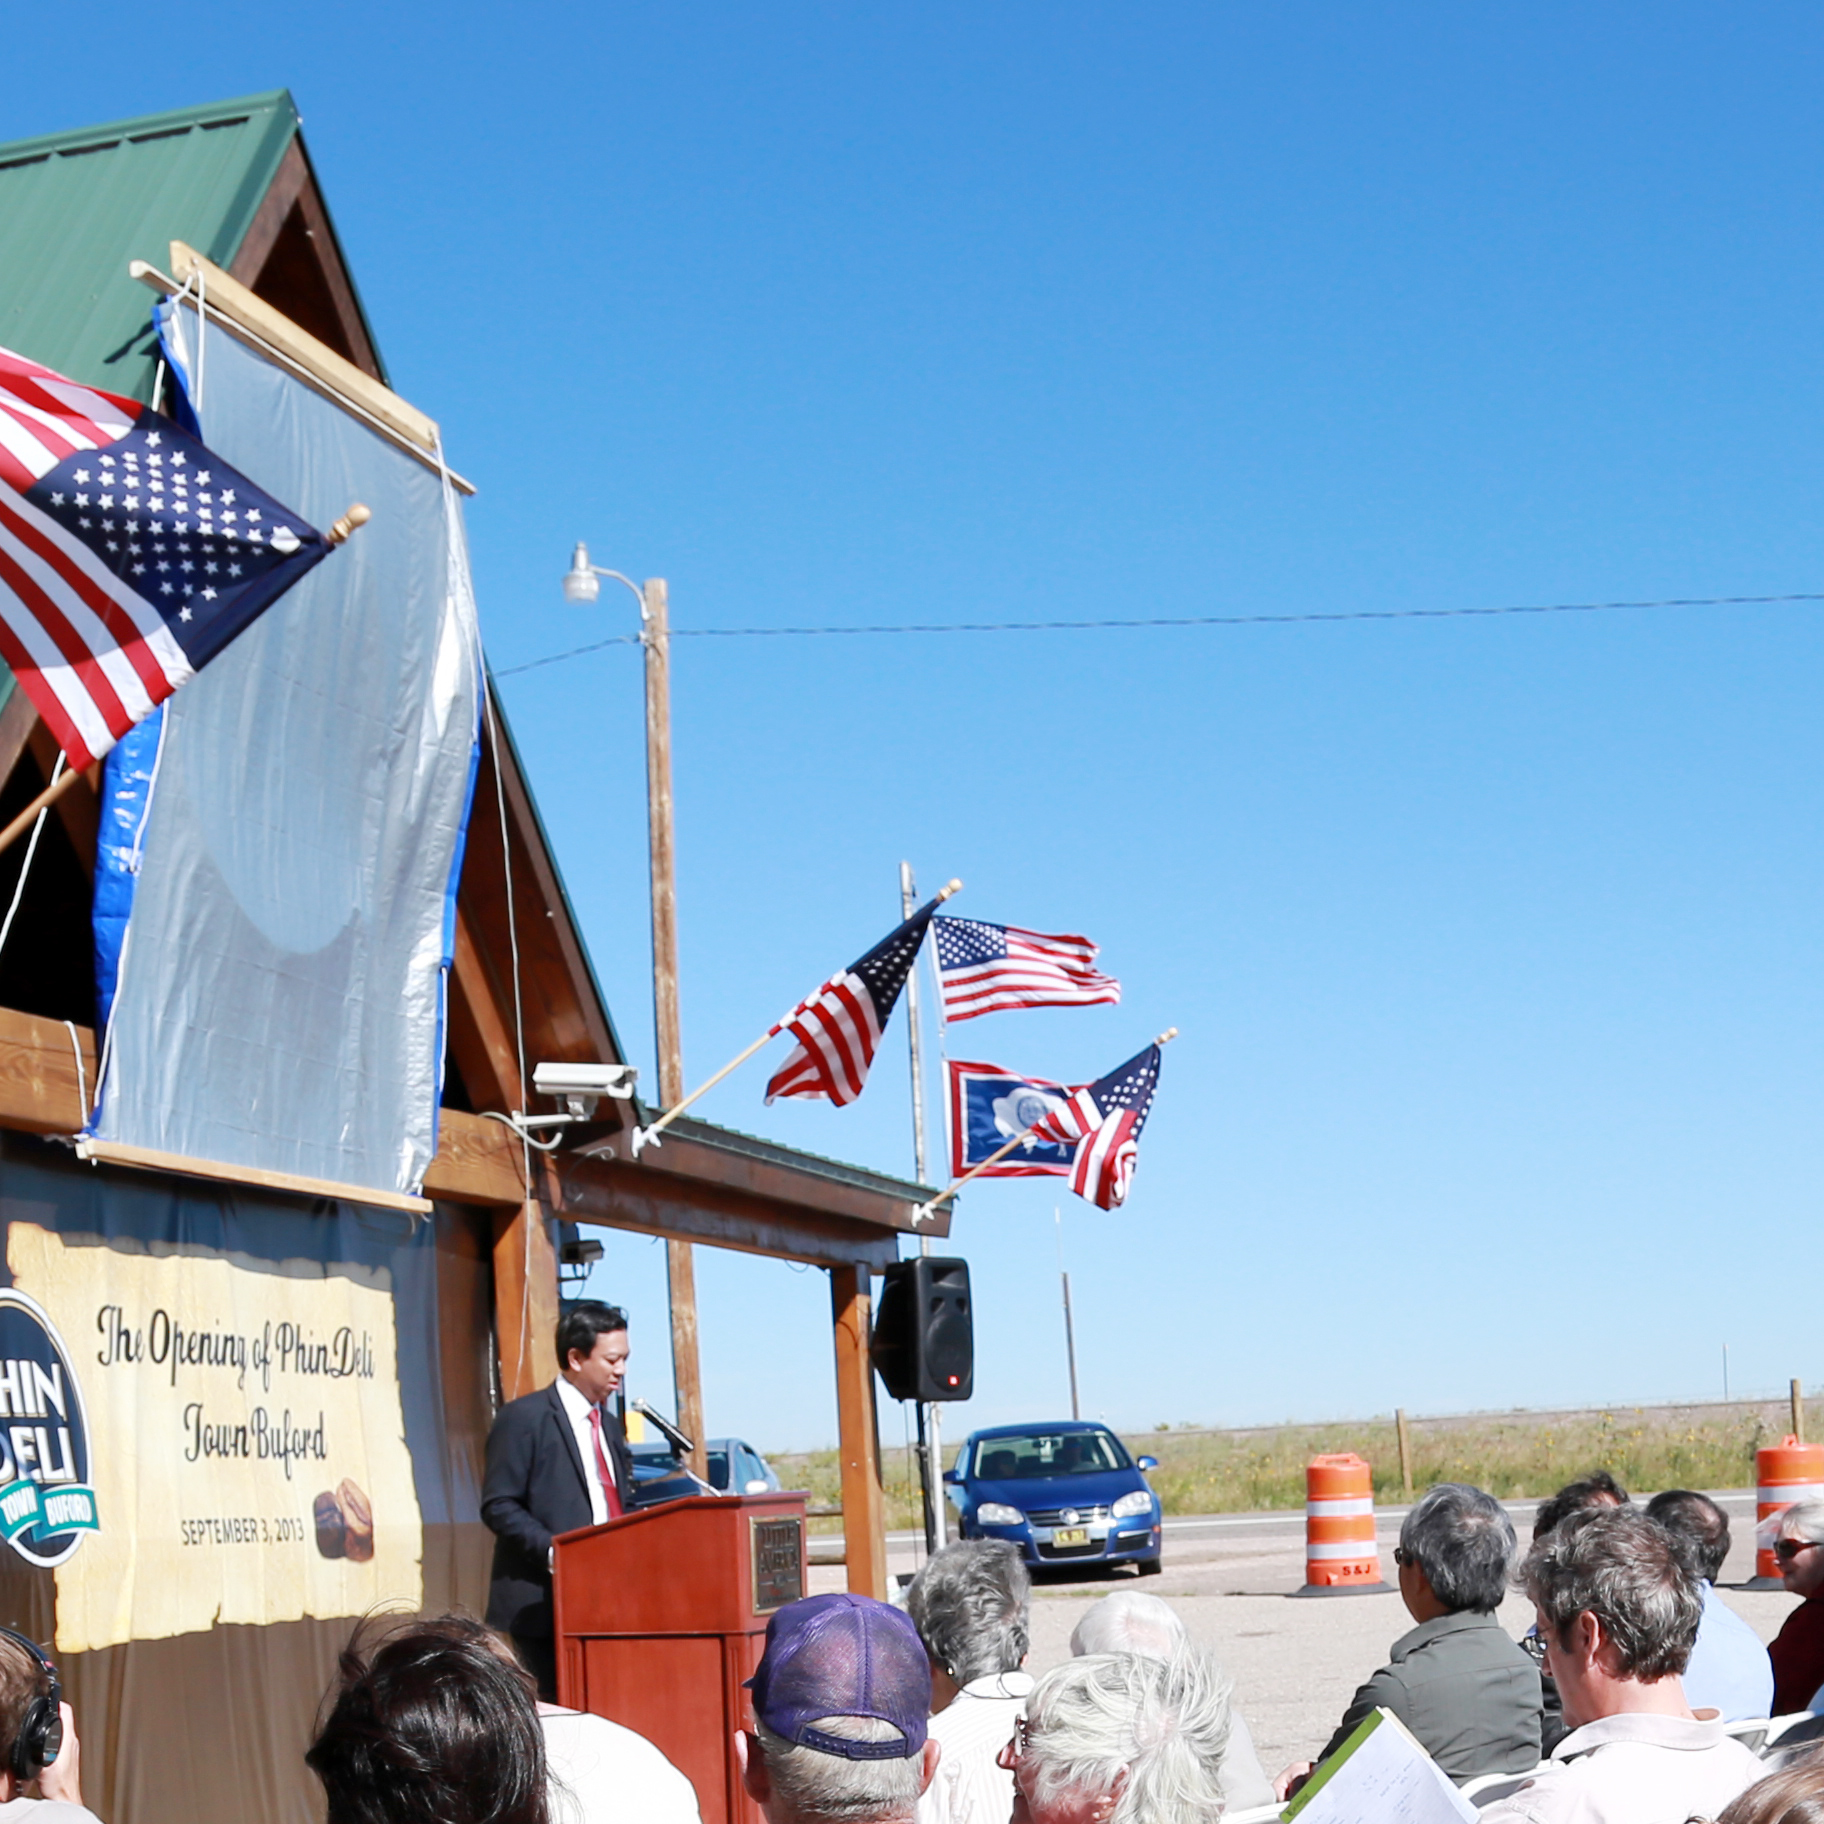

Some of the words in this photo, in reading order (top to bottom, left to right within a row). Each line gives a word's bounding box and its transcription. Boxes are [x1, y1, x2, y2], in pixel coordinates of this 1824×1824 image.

[96, 1304, 145, 1366] The
[149, 1309, 249, 1390] Opening
[252, 1320, 272, 1393] of
[275, 1322, 375, 1380] PhinDeli
[183, 1402, 249, 1463] Town
[250, 1406, 327, 1481] Buford
[0, 1485, 38, 1526] TOWN
[44, 1493, 93, 1527] BUFORD
[180, 1518, 259, 1546] SEPTEMBER
[261, 1518, 273, 1545] 3,
[275, 1518, 305, 1542] 2013
